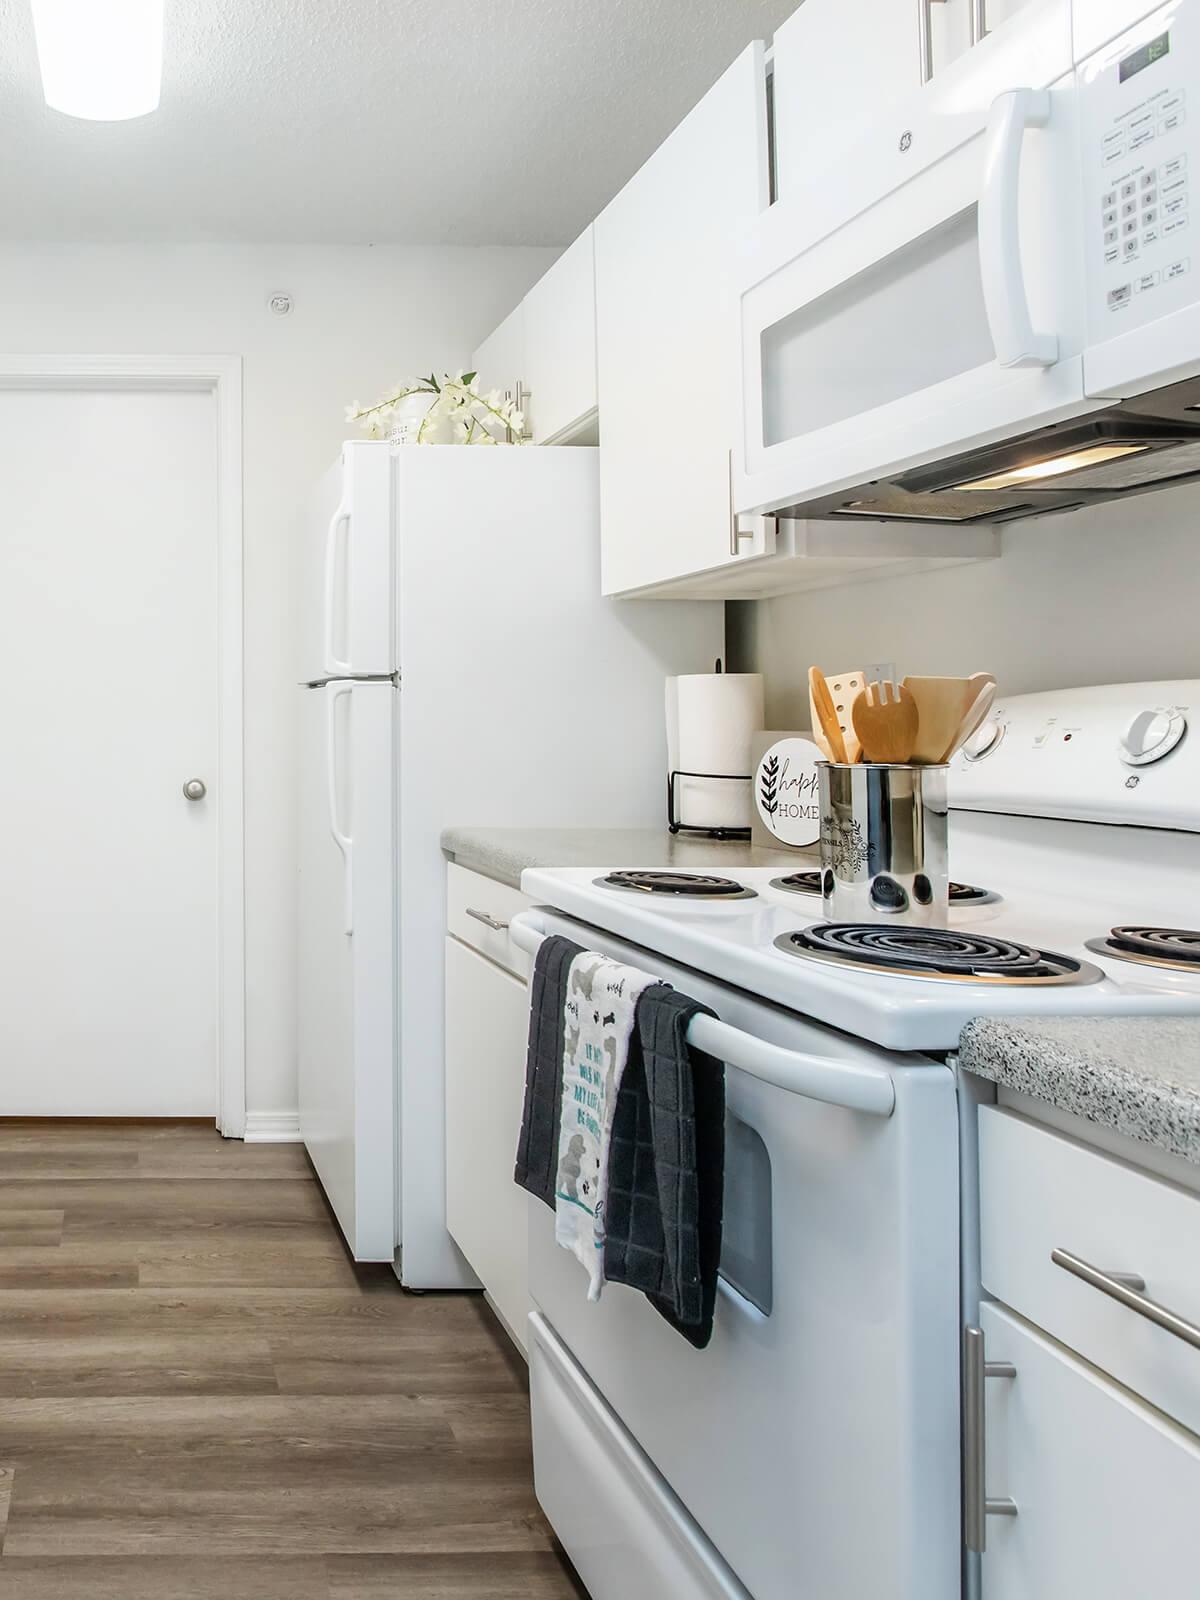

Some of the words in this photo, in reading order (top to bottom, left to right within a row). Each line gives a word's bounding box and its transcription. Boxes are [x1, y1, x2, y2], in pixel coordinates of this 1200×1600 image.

[779, 757, 820, 798] happ
[778, 803, 820, 820] HOME
[566, 1002, 579, 1021] oof
